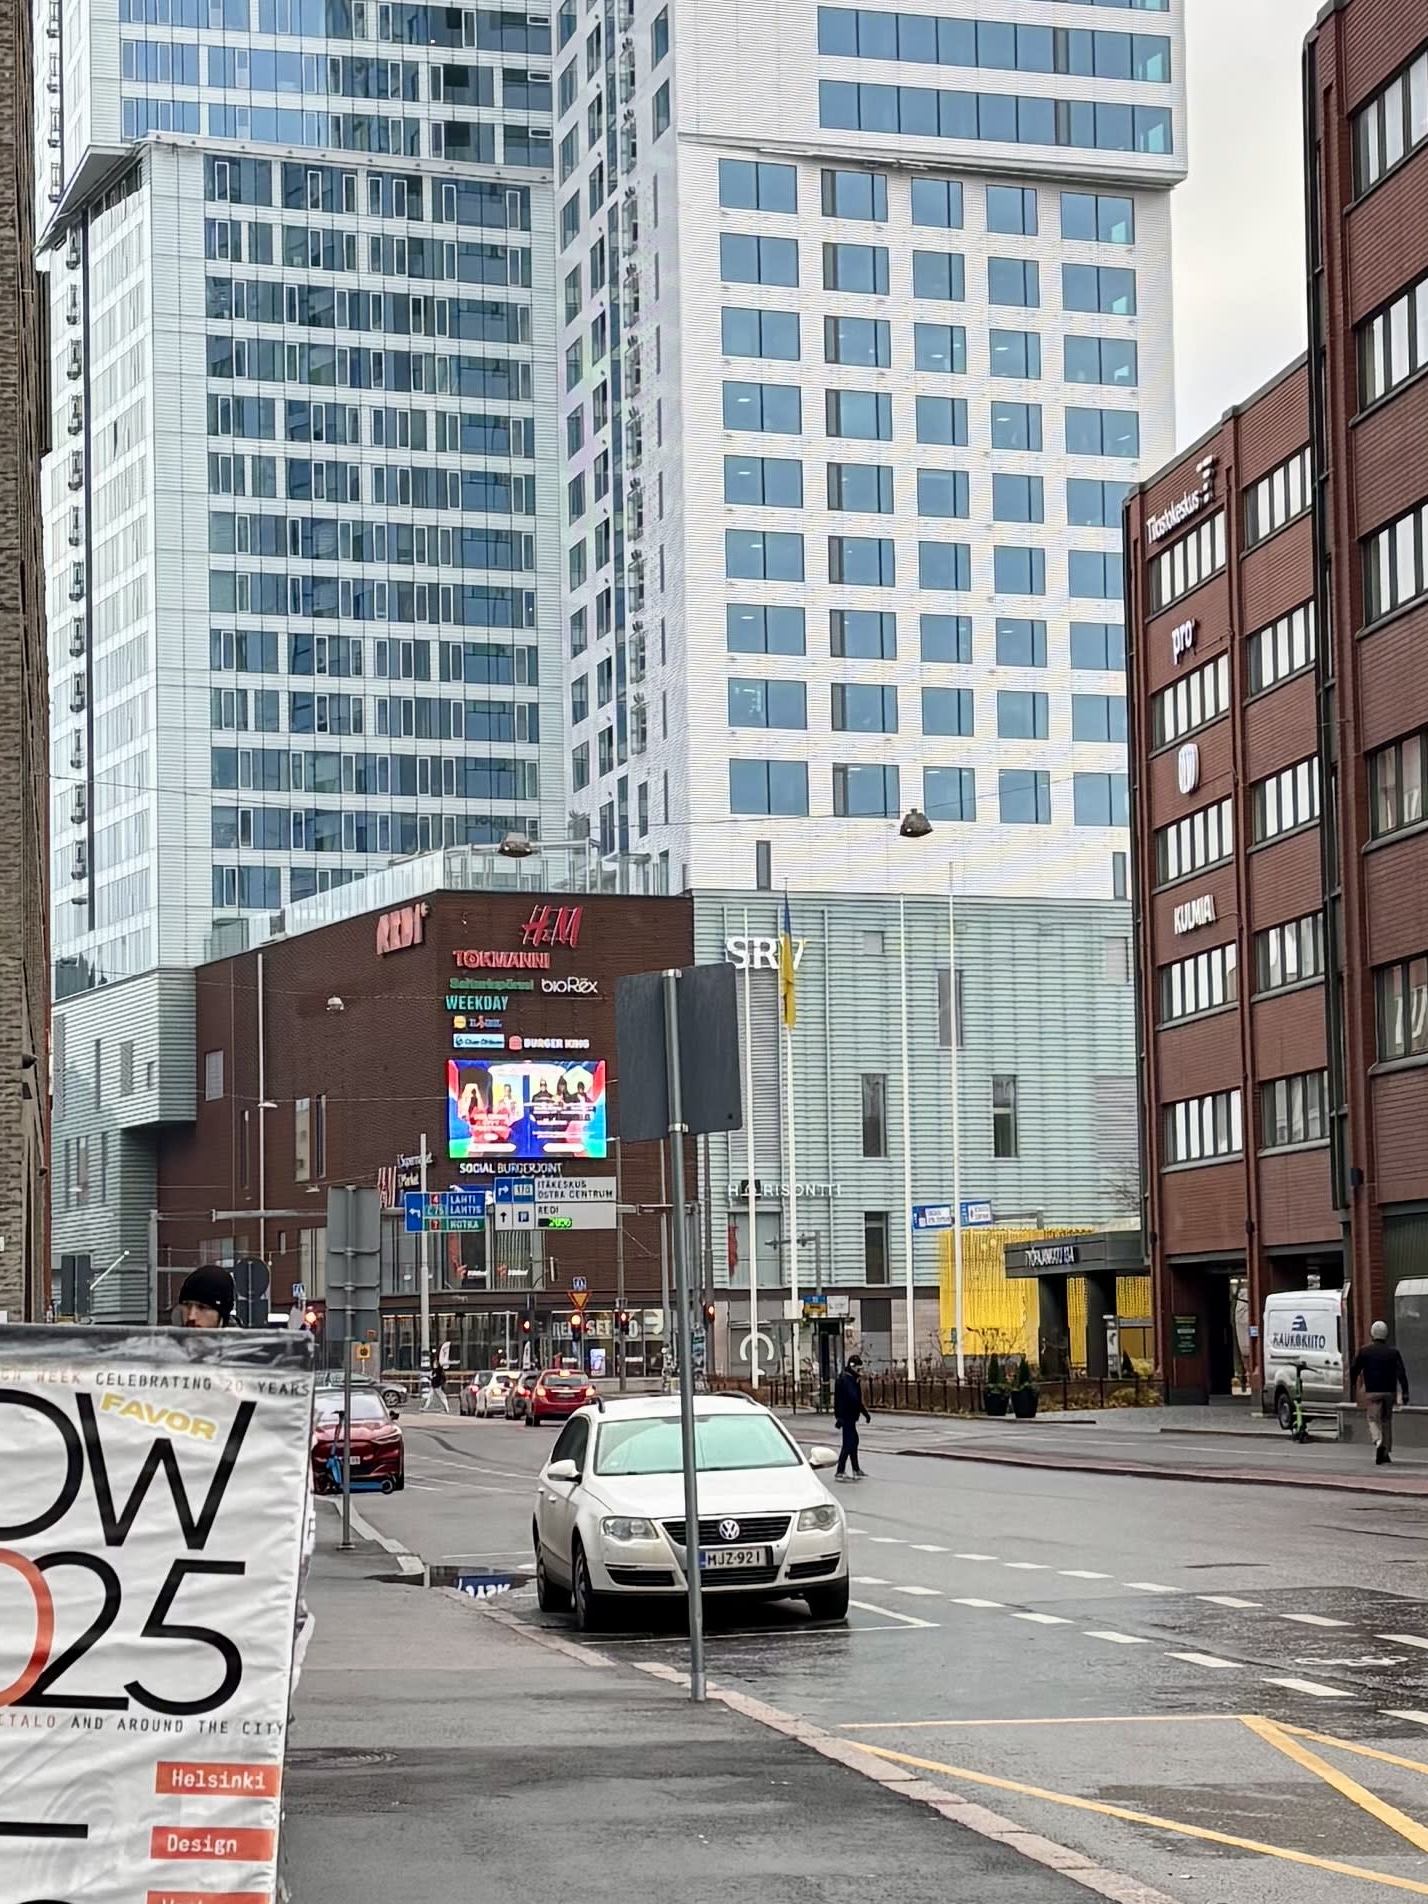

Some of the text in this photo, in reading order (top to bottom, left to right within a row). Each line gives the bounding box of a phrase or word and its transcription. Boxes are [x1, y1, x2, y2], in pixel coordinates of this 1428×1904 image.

[522, 904, 585, 948] H&M
[453, 949, 551, 969] TOKMANNI
[444, 994, 509, 1011] WEEKDAY
[524, 1038, 590, 1049] BURGER KING
[460, 1162, 496, 1174] SOCIAL
[450, 1194, 476, 1205] LAHTI
[568, 1189, 613, 1199] CENTRUM
[537, 1205, 559, 1215] REDI
[1273, 1333, 1326, 1349] KAUKOKIITO
[36, 1368, 81, 1385] WEEK
[95, 1371, 212, 1392] CELEBRATING
[223, 1377, 244, 1394] 20
[257, 1381, 311, 1397] YEARS
[99, 1391, 217, 1441] FAVOR
[71, 1715, 103, 1731] AND
[117, 1717, 184, 1733] AROUND
[199, 1719, 229, 1735] THE
[241, 1720, 285, 1737] CITY
[172, 1767, 266, 1791] Helsinki
[166, 1833, 238, 1856] Design
